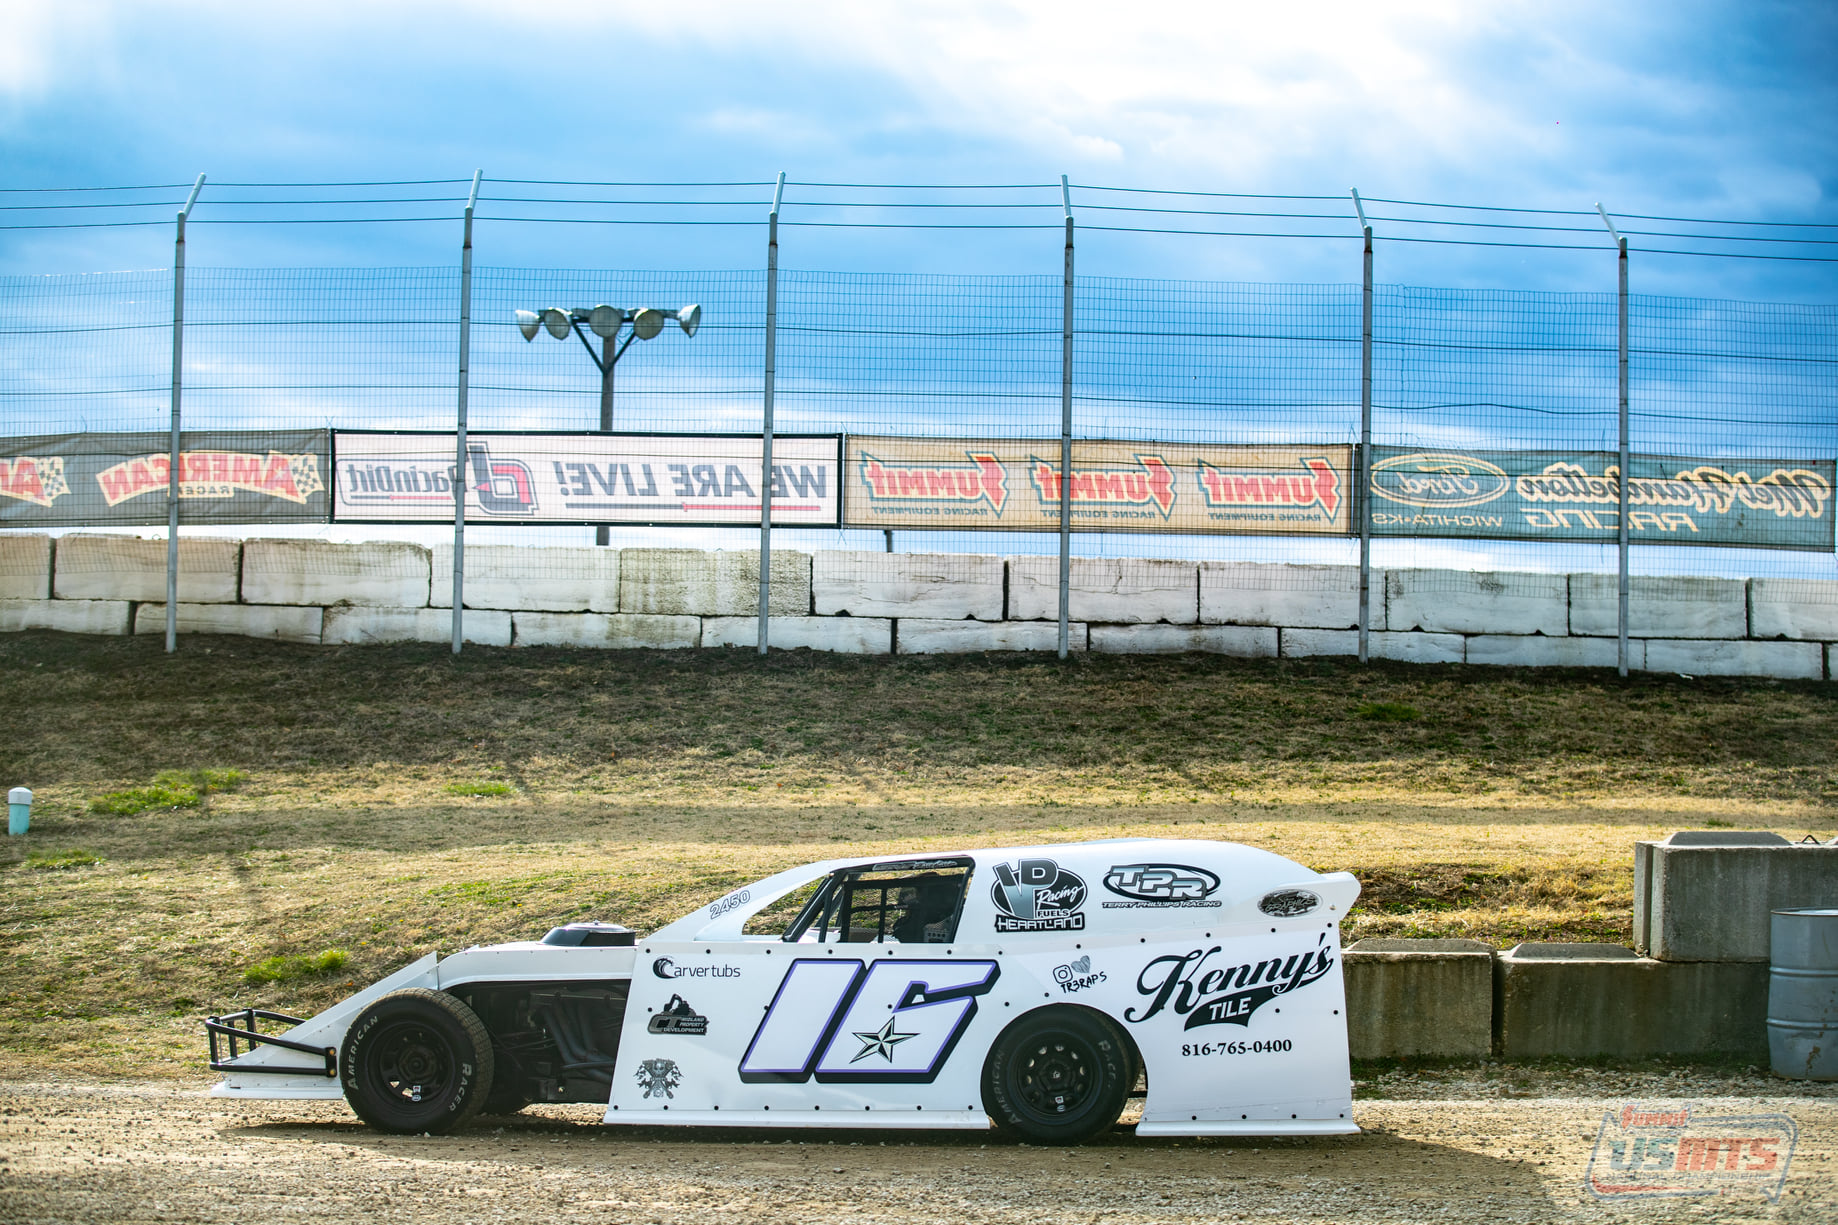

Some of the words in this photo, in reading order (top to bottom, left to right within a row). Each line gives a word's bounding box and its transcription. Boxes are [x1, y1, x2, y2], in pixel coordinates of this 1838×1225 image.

[993, 858, 1058, 918] VP
[1110, 865, 1207, 900] TPR
[710, 890, 751, 920] 2450
[1036, 885, 1081, 909] Racing
[1181, 900, 1222, 908] RACING
[997, 915, 1083, 930] HEARTLAND
[1037, 909, 1069, 917] FUELS
[1060, 971, 1107, 994] TR3RAPS
[1124, 932, 1334, 1023] Kenny's
[738, 958, 1000, 1084] 16
[1208, 997, 1251, 1020] TILE
[347, 1015, 379, 1091] AMERICAN
[1182, 1039, 1292, 1057] 816-765-0400
[449, 1063, 473, 1112] RACER
